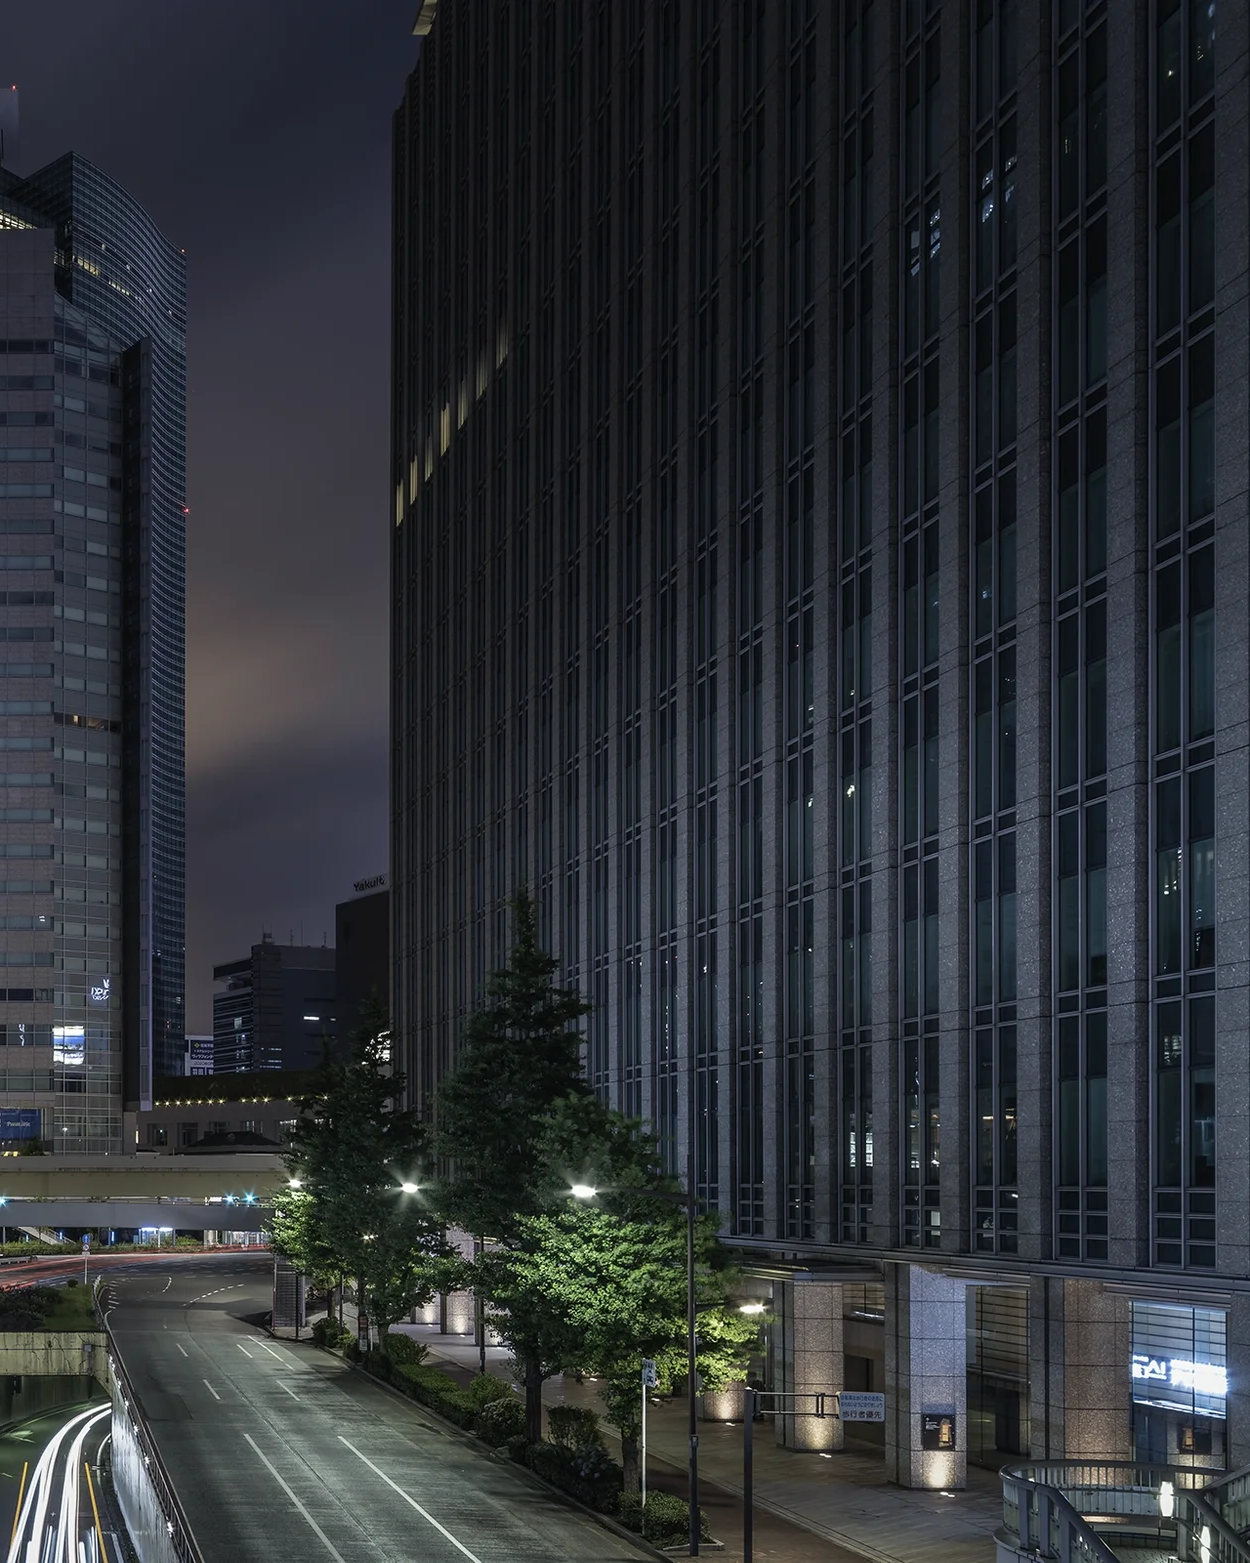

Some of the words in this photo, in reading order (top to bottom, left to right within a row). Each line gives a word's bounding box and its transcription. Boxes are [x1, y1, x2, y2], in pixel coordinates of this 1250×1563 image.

[353, 875, 385, 892] Yakult
[842, 1410, 882, 1419] 歩行者優先
